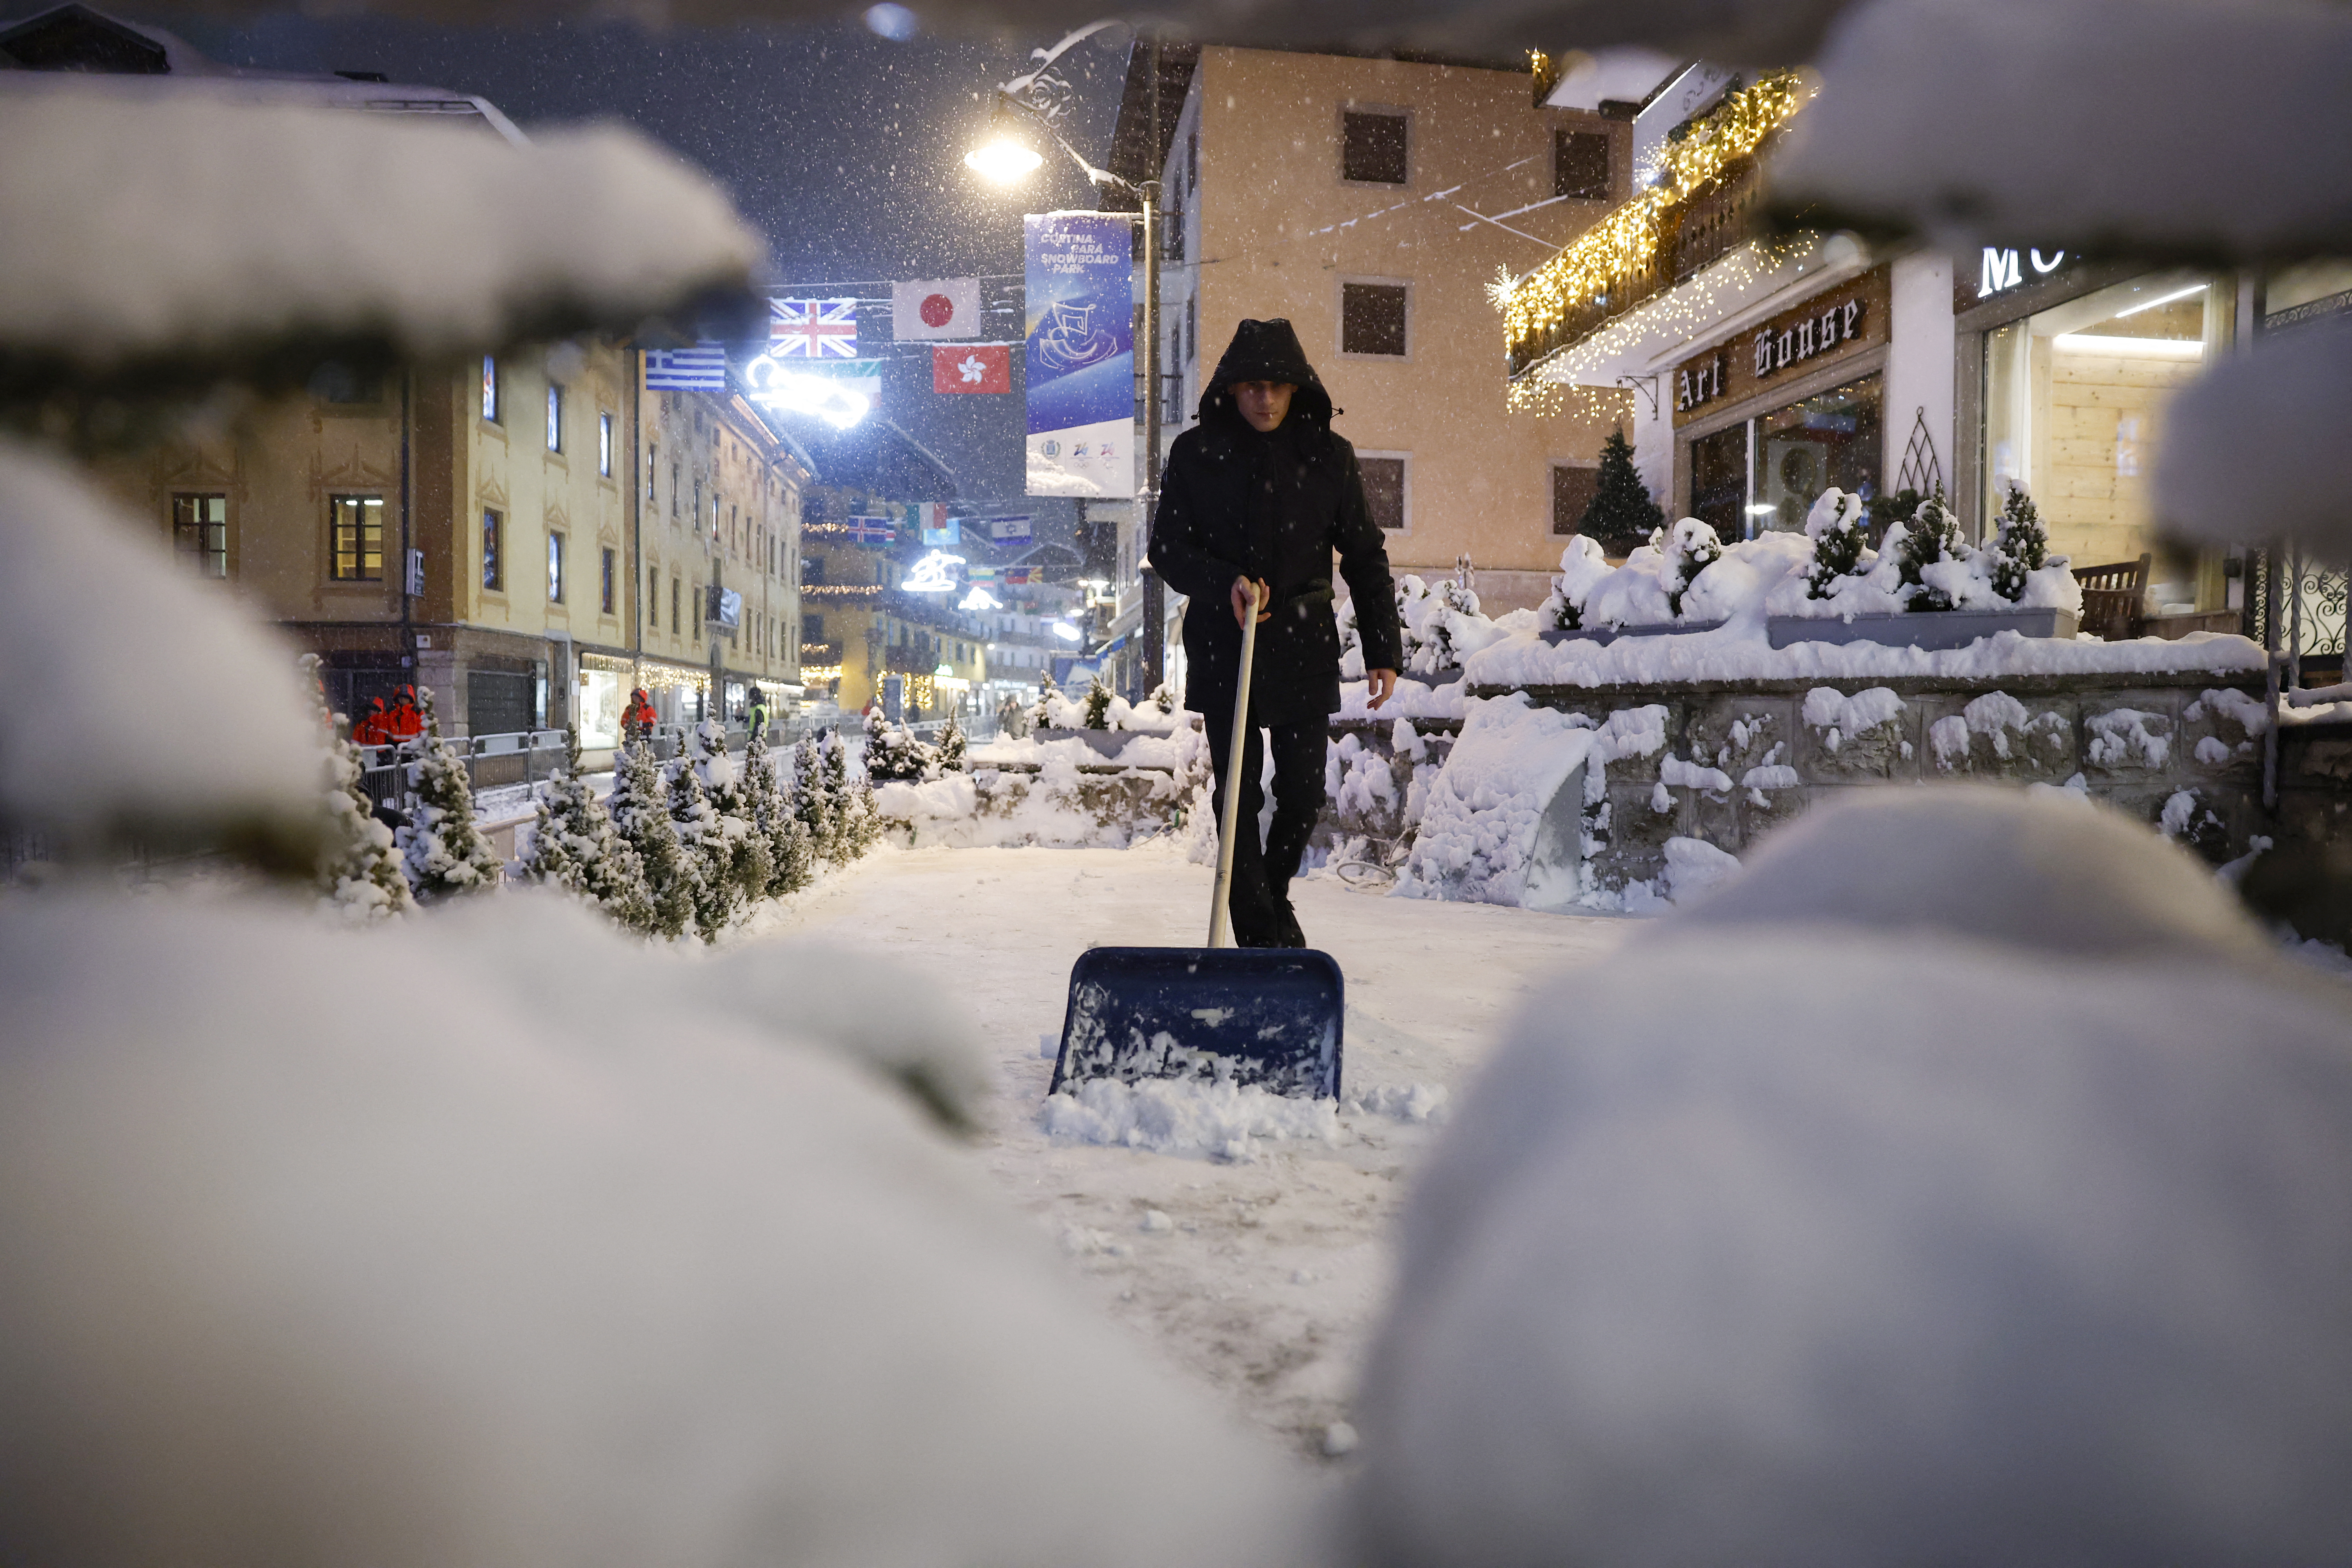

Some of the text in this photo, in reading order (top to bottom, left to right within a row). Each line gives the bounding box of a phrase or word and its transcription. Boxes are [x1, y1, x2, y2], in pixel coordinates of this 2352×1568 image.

[1041, 234, 1093, 243] CORTINA
[1071, 243, 1103, 254] PARA
[1041, 253, 1119, 264] SNOWBOARD
[1053, 263, 1085, 274] PARK
[1677, 298, 1858, 412] Art House
